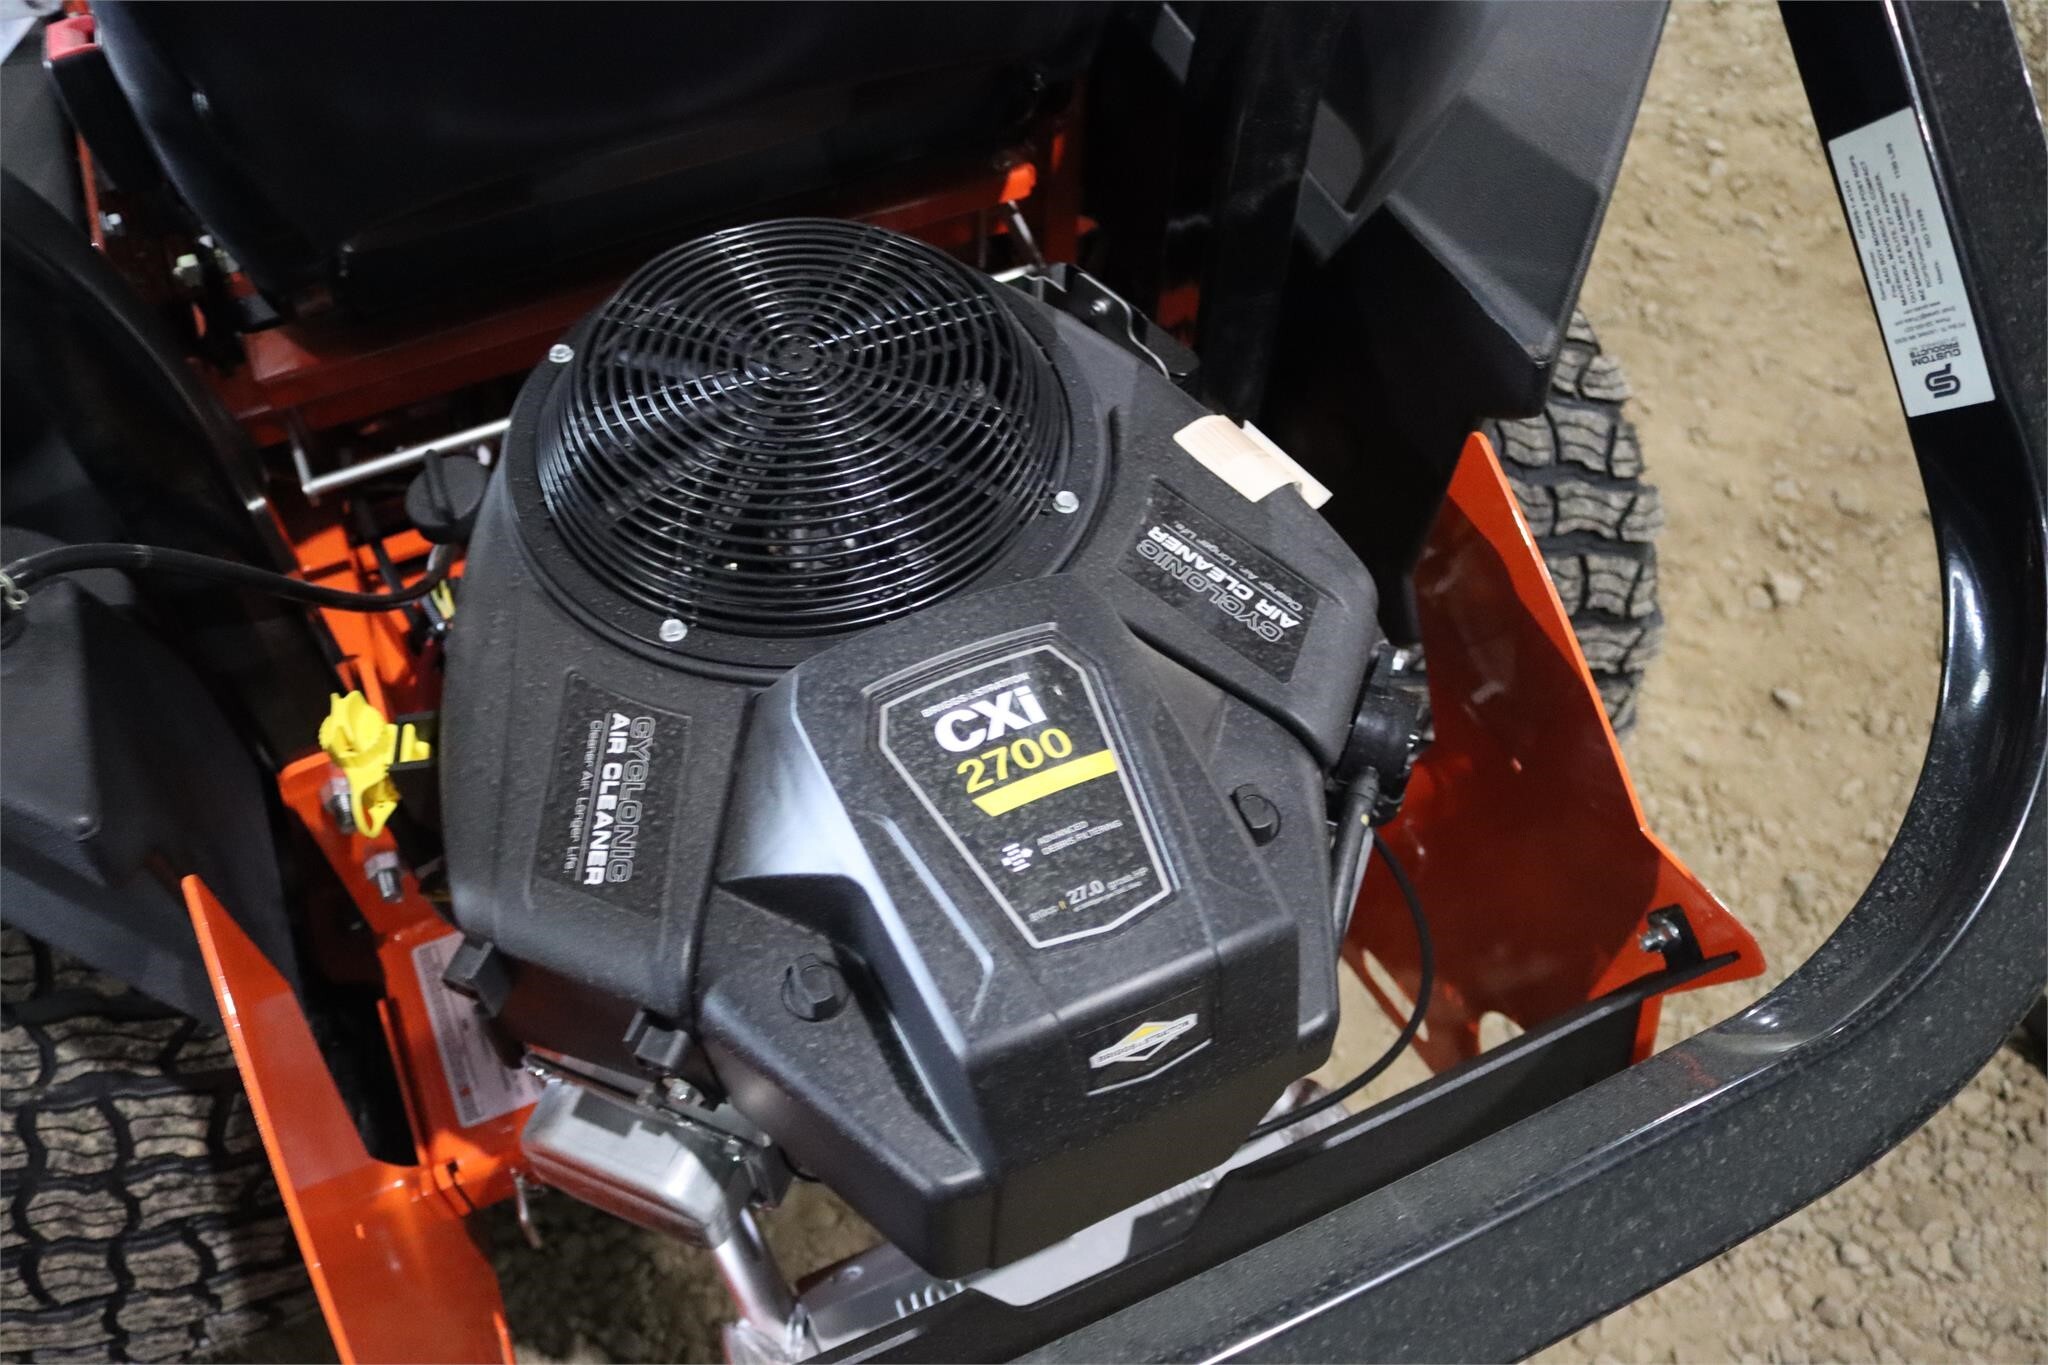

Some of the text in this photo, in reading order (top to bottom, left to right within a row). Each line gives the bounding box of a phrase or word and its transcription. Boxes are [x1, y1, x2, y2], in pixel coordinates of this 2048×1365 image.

[1909, 341, 1959, 358] PRODUCTS
[1910, 348, 1961, 366] CUSTOM
[1136, 539, 1284, 642] CYCLONIC
[1147, 525, 1300, 628] AIR CLEANER
[934, 686, 1048, 753] CXi
[956, 728, 1073, 794] 2700
[583, 712, 630, 885] AIR CLEANER
[605, 716, 656, 883] CYCLONIC
[1036, 819, 1089, 845] ADVANCED
[1064, 878, 1106, 905] 27.0
